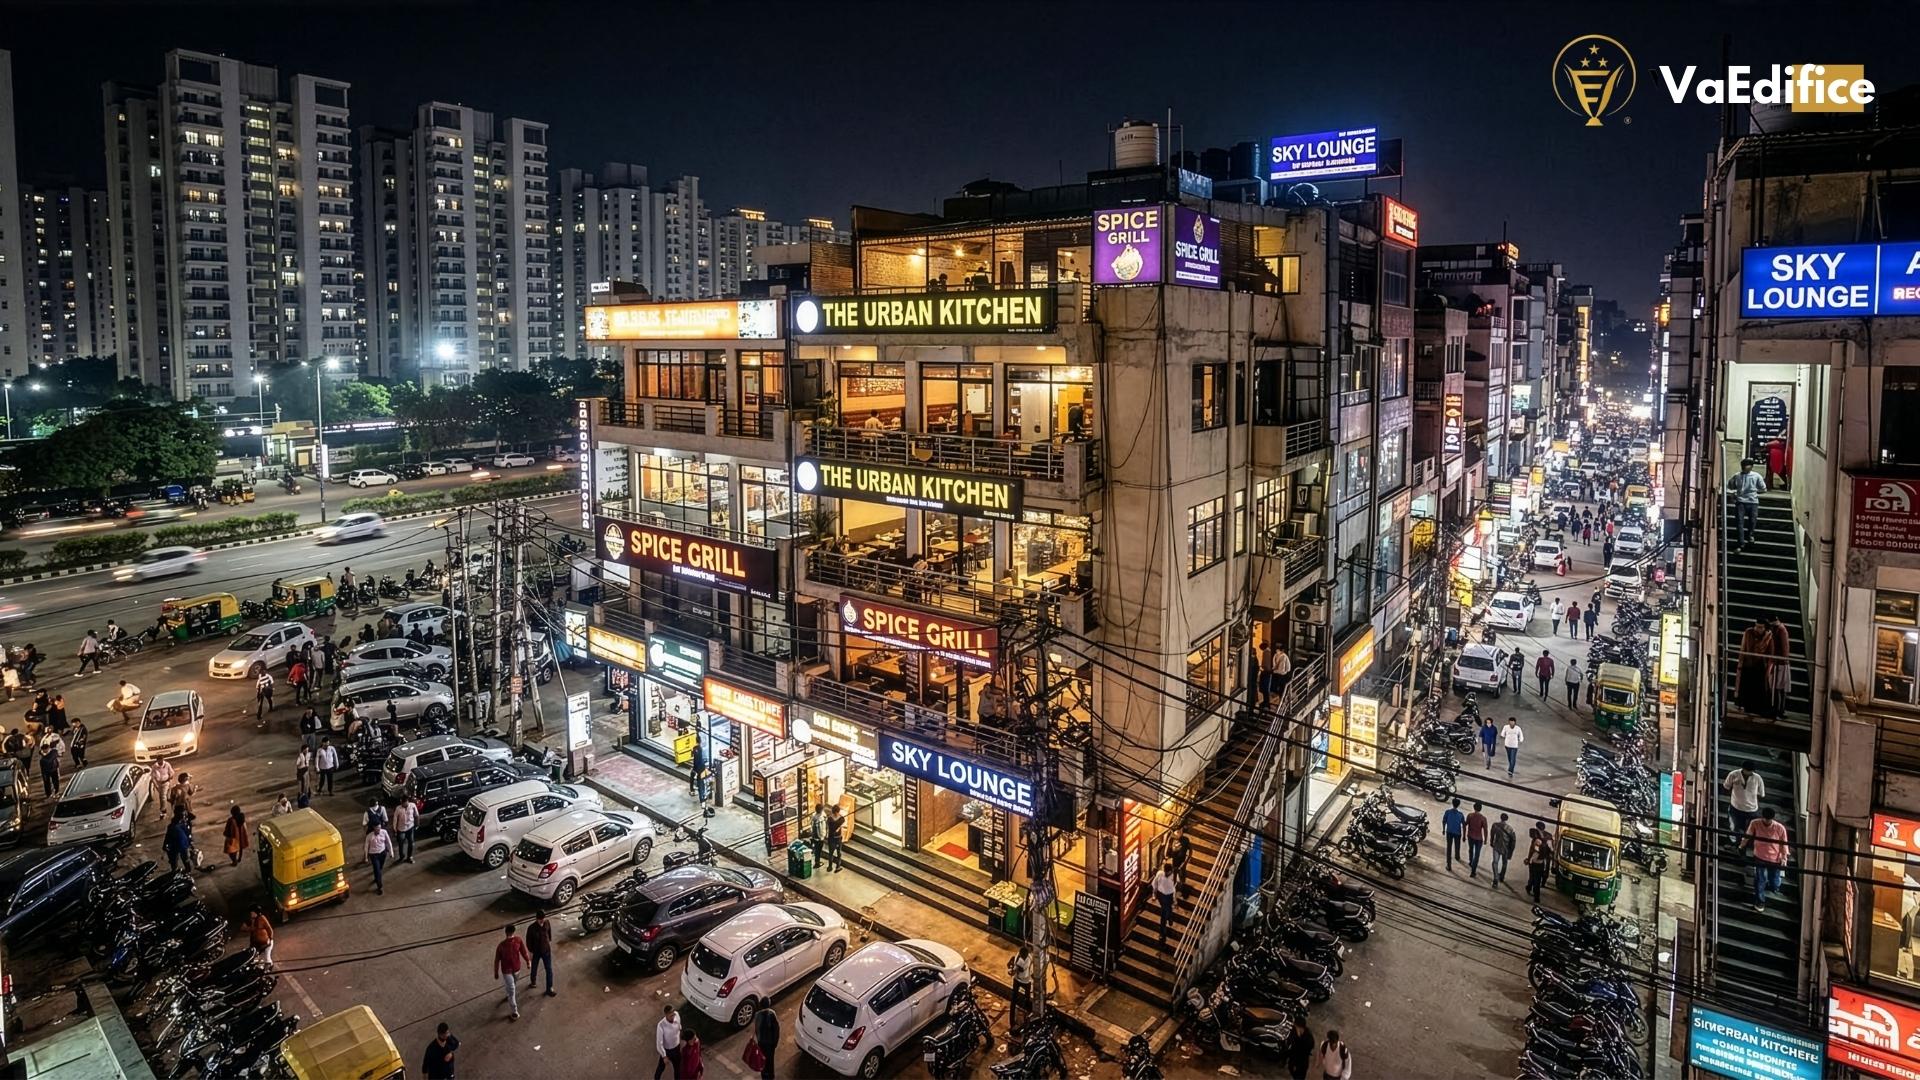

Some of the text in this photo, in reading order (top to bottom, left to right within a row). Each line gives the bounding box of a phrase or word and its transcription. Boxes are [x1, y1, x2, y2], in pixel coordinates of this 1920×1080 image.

[1272, 144, 1304, 163] SKY
[1308, 136, 1376, 159] LOUNGE
[1097, 210, 1158, 232] SPICE
[1107, 231, 1150, 245] GRILL
[1175, 241, 1220, 265] SPICE GRILL
[1771, 252, 1846, 282] SKY
[822, 296, 1042, 327] THE URBAN KITCHEN
[1747, 285, 1869, 309] LOUNGE
[820, 464, 852, 489] THE
[856, 468, 916, 497] URBAN
[922, 475, 1009, 509] KITCHEN
[631, 530, 683, 564] SPICE
[687, 542, 746, 578] GRILL
[863, 608, 920, 641] SPICE
[926, 622, 990, 657] GRILL
[891, 741, 932, 771] SKY
[938, 755, 1032, 807] LOUNGE
